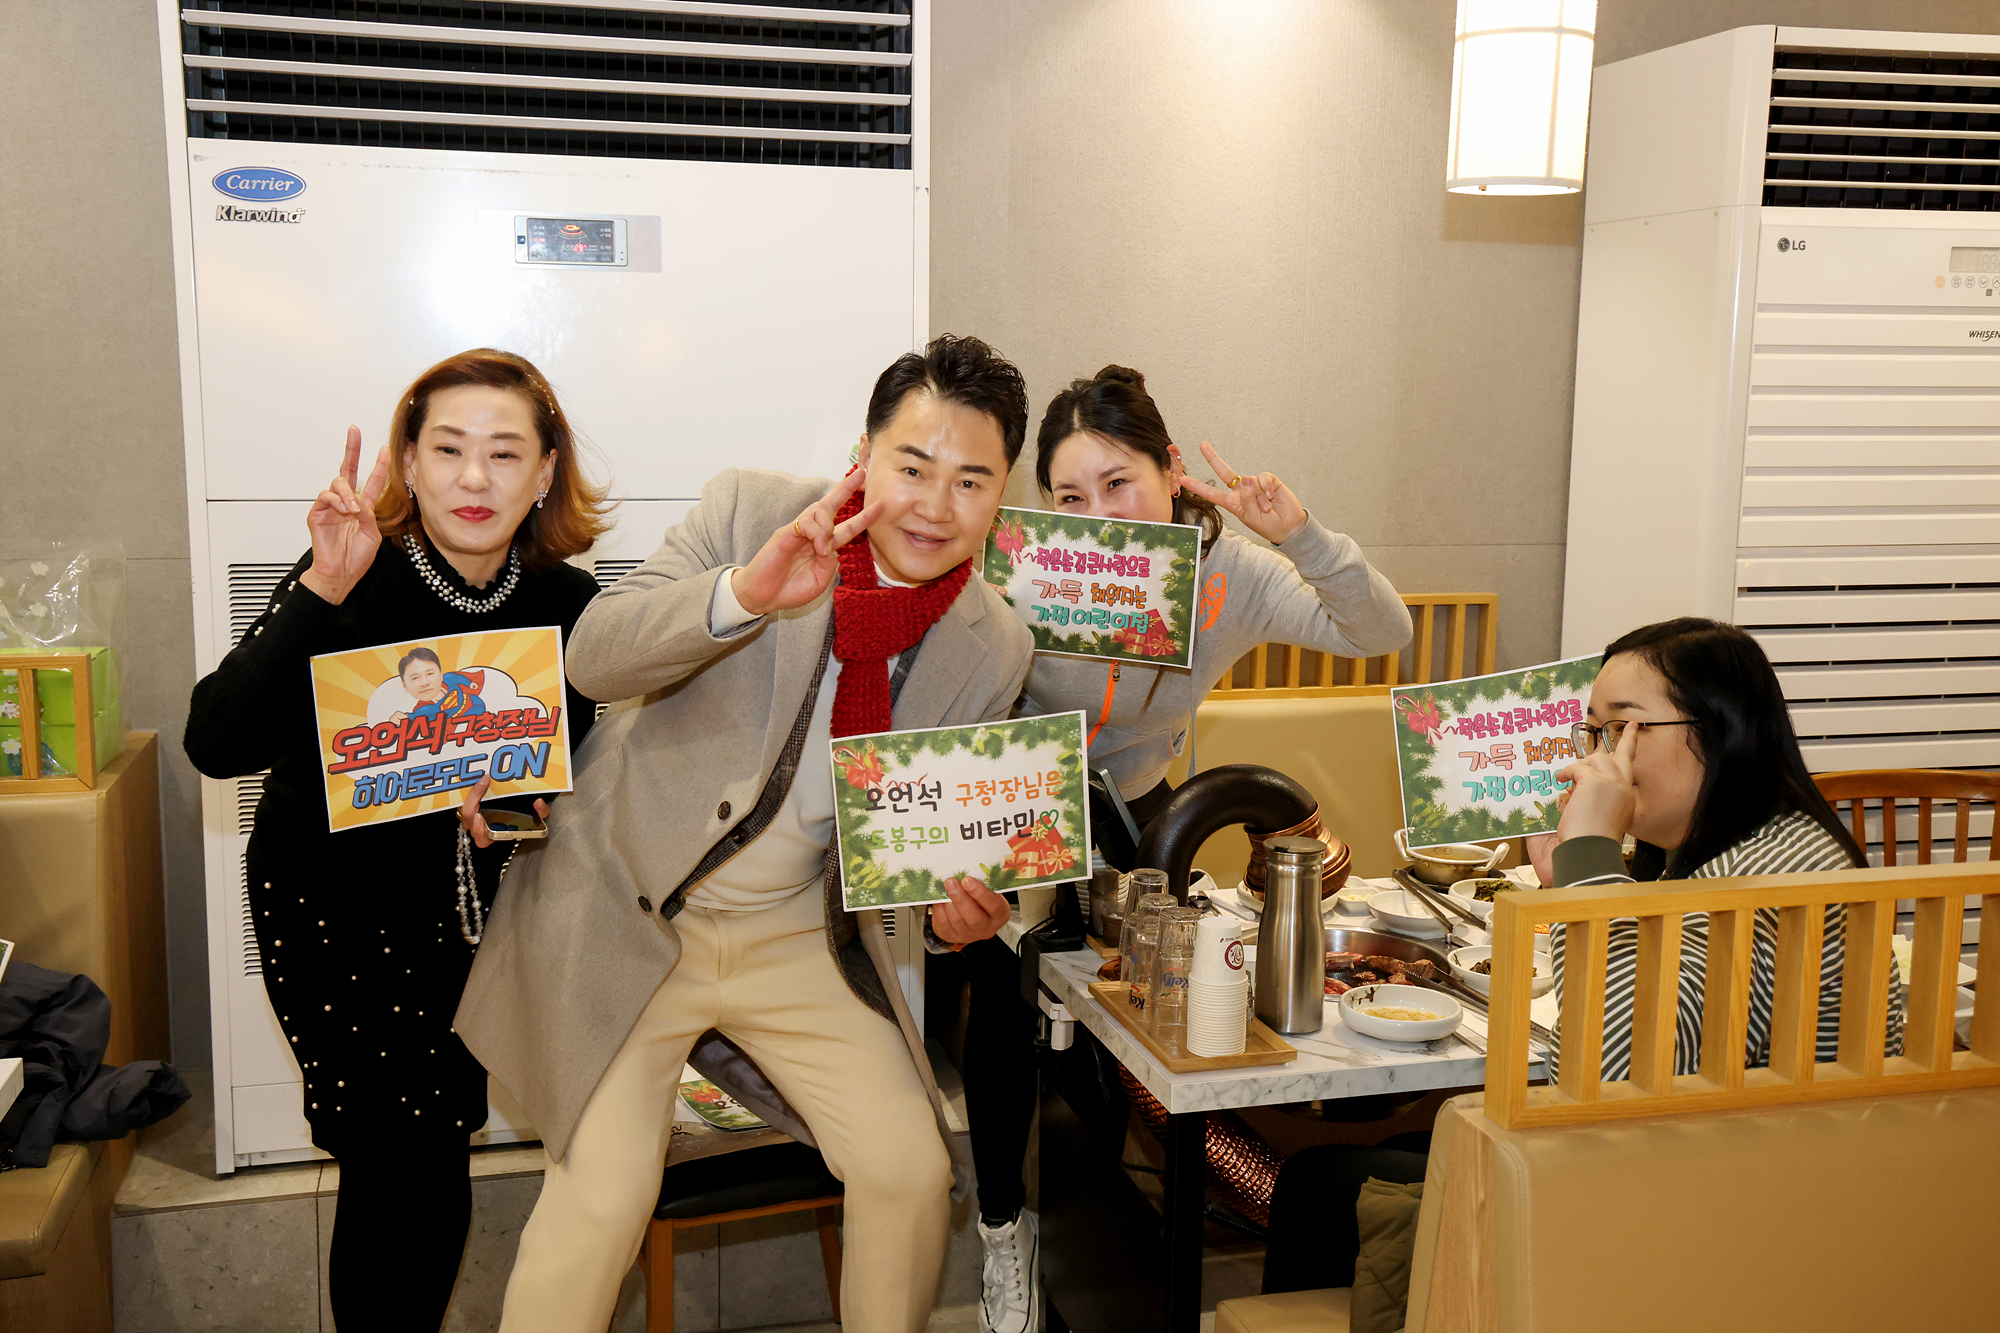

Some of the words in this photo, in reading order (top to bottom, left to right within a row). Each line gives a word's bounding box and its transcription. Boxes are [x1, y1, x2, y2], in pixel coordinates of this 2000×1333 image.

[226, 174, 295, 191] Carrier
[215, 205, 305, 223] Klarwind
[1792, 240, 1806, 251] LG
[1032, 579, 1084, 604] 가득
[1091, 582, 1147, 609] 채워지는
[1031, 604, 1070, 626] 가정
[1071, 607, 1149, 634] 어린이집
[328, 712, 448, 775] 오언석
[446, 706, 561, 746] 구청장님
[1459, 744, 1517, 771] 가득
[352, 753, 489, 809] 히어로모드
[490, 742, 551, 782] ON
[1462, 776, 1506, 802] 가정
[865, 780, 942, 813] 오언석
[955, 770, 1062, 807] 구청장님은
[871, 826, 949, 853] 도봉구의
[959, 809, 1035, 840] 비타민
